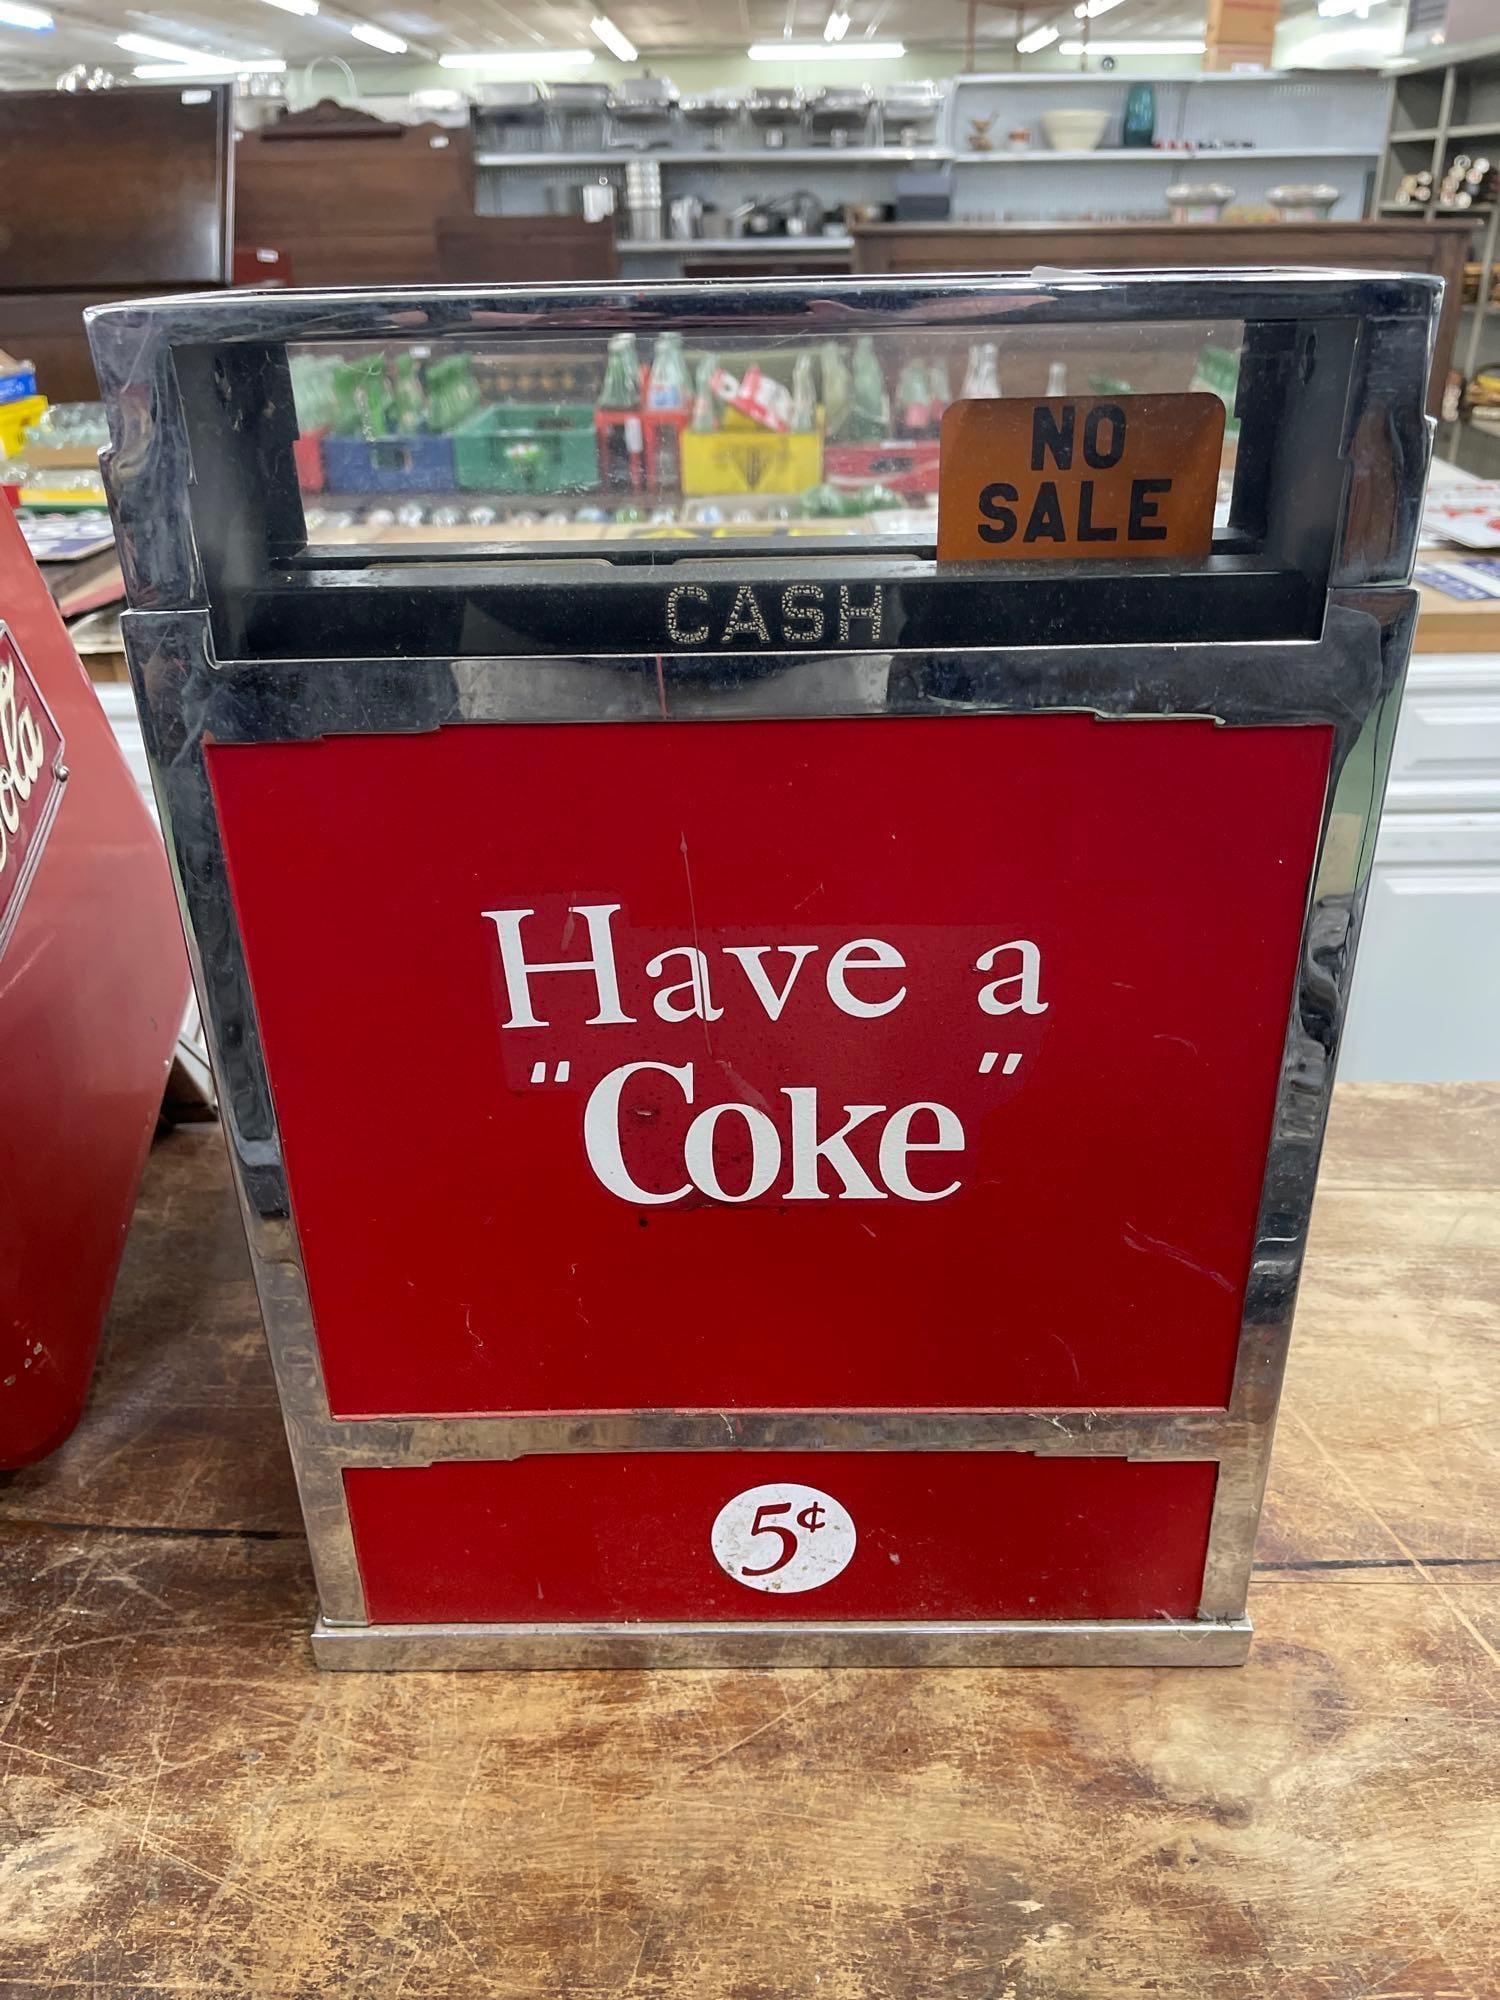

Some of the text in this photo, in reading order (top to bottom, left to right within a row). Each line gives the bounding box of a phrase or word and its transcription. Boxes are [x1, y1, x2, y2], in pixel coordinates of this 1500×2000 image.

[1031, 404, 1127, 471] NO
[977, 479, 1173, 543] SALE
[666, 584, 884, 645] CASH
[481, 904, 1049, 1028] Have a
[741, 1501, 826, 1577] 5¢
